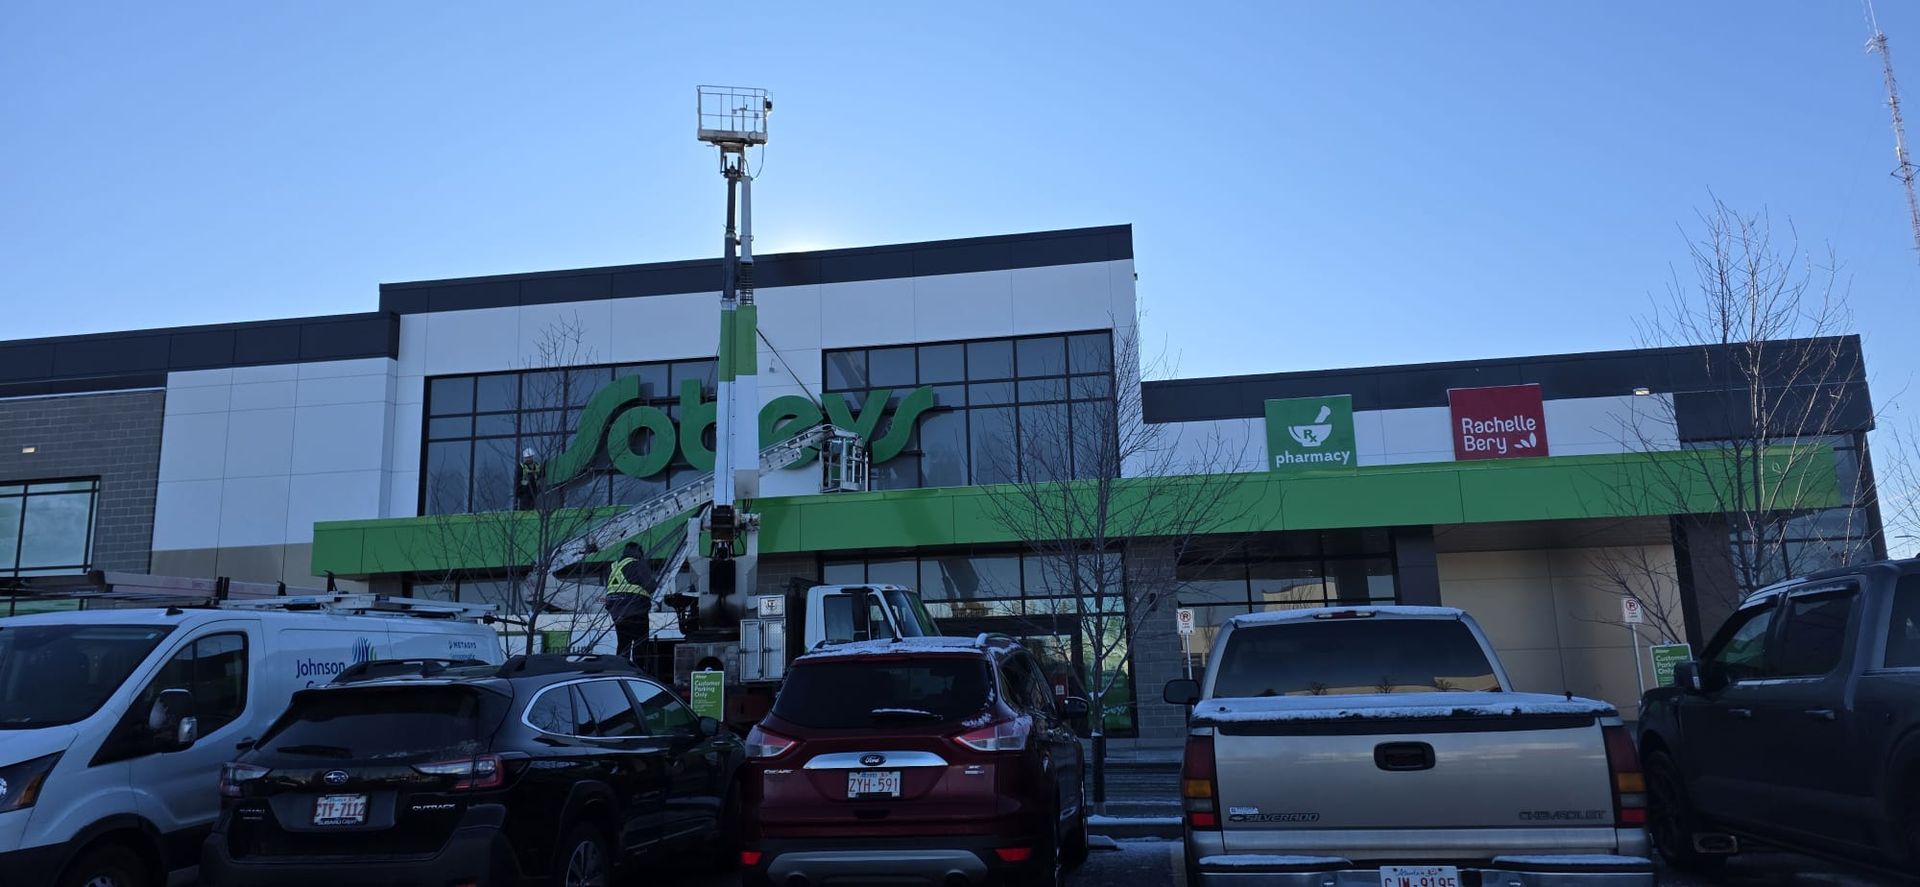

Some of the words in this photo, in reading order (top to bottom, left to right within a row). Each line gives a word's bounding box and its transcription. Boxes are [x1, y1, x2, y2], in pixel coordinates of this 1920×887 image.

[546, 374, 935, 485] Sobeys
[1461, 415, 1536, 435] Rachelle
[1463, 435, 1507, 454] Bery
[1275, 449, 1351, 468] pharmacy
[296, 658, 345, 679] Johnson
[1246, 813, 1320, 823] SILVERADO
